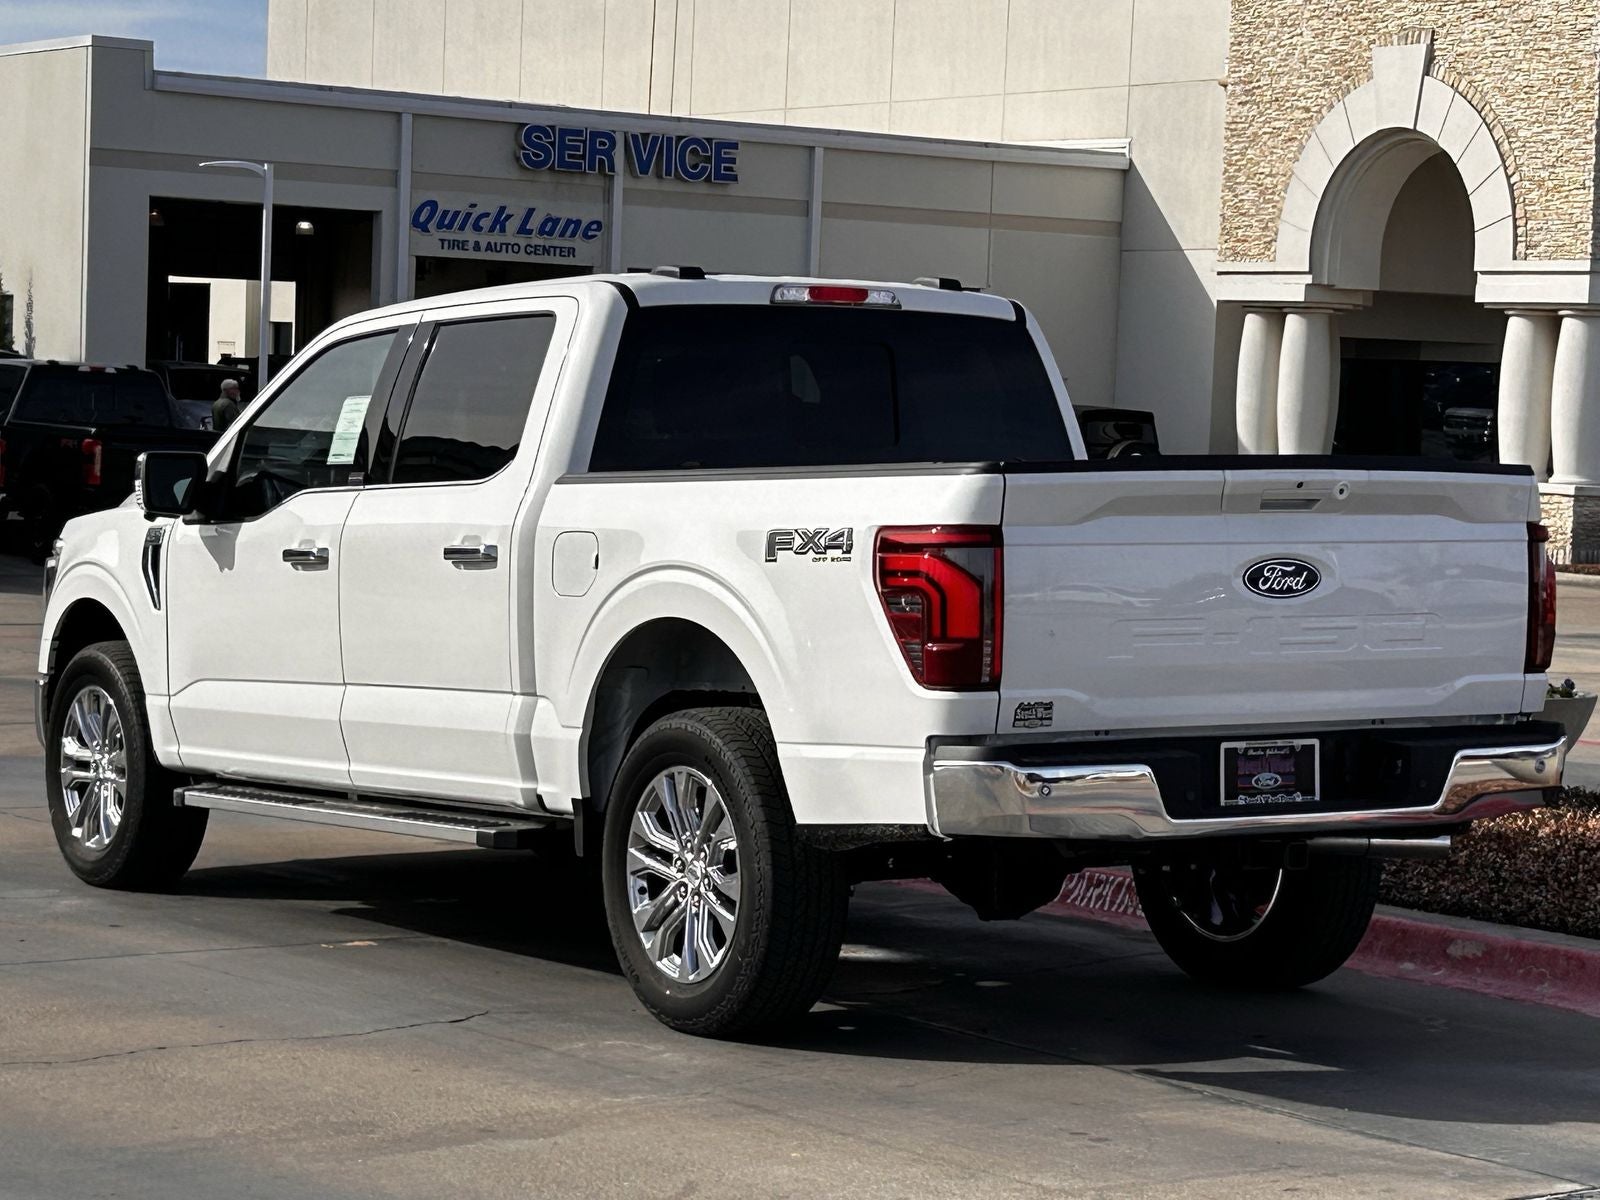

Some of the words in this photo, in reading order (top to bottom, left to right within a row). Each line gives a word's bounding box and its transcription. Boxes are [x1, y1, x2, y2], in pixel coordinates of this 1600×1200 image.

[519, 123, 739, 184] SERVICE
[411, 199, 515, 235] Quick
[515, 207, 603, 241] Lane
[438, 238, 470, 252] TIRE
[472, 241, 482, 252] &
[485, 242, 521, 255] AUTO
[524, 244, 577, 258] CENTER
[765, 527, 853, 562] FX4
[1259, 565, 1307, 590] Ford
